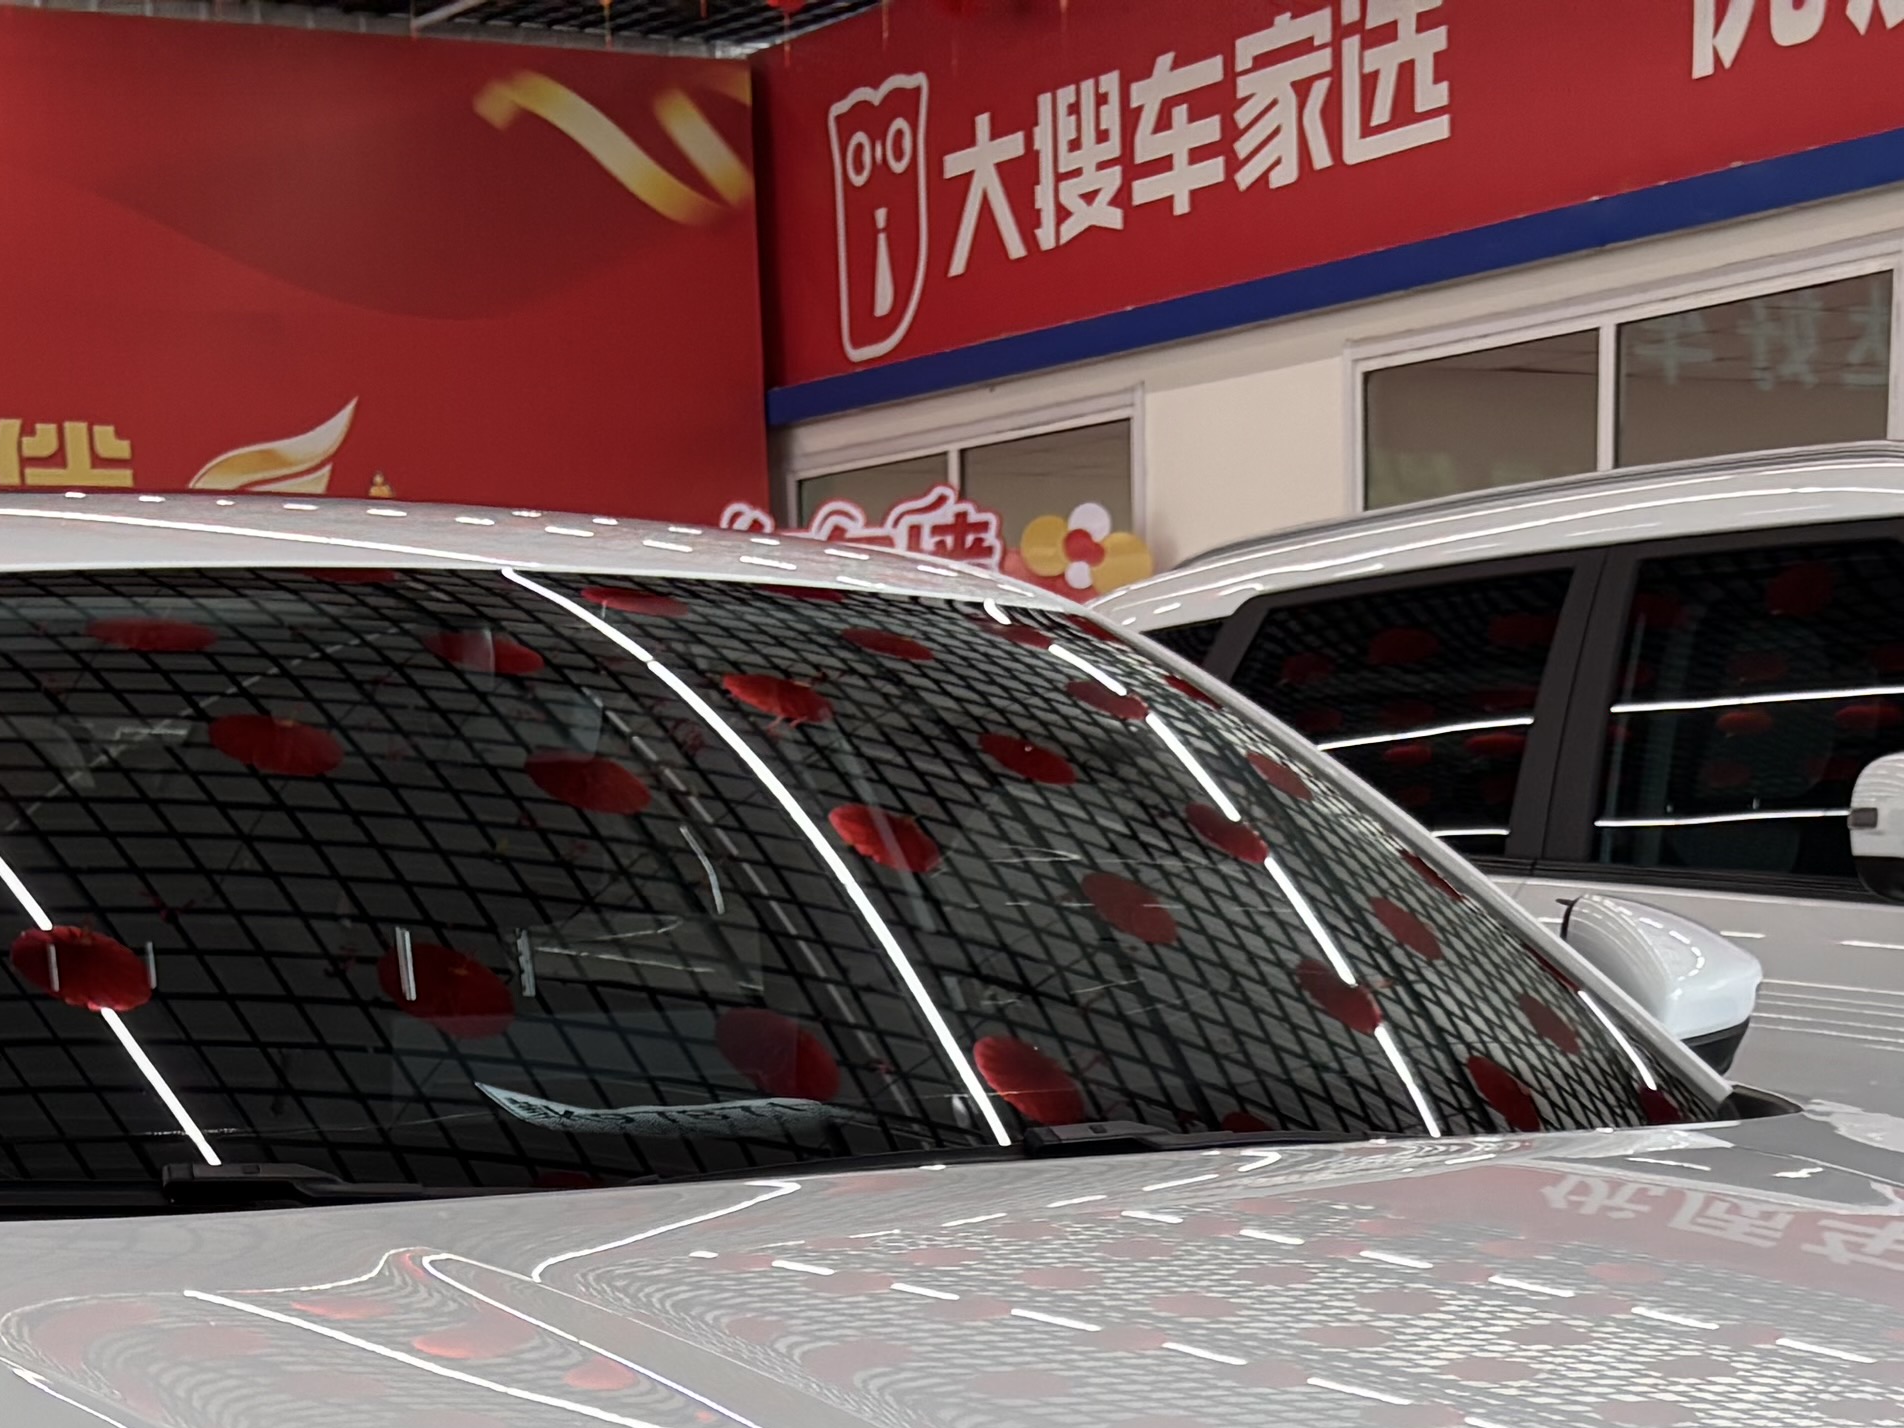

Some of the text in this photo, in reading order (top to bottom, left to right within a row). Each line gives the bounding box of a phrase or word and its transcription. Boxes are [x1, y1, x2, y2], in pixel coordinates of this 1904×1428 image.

[943, 0, 1452, 278] 大搜车家选
